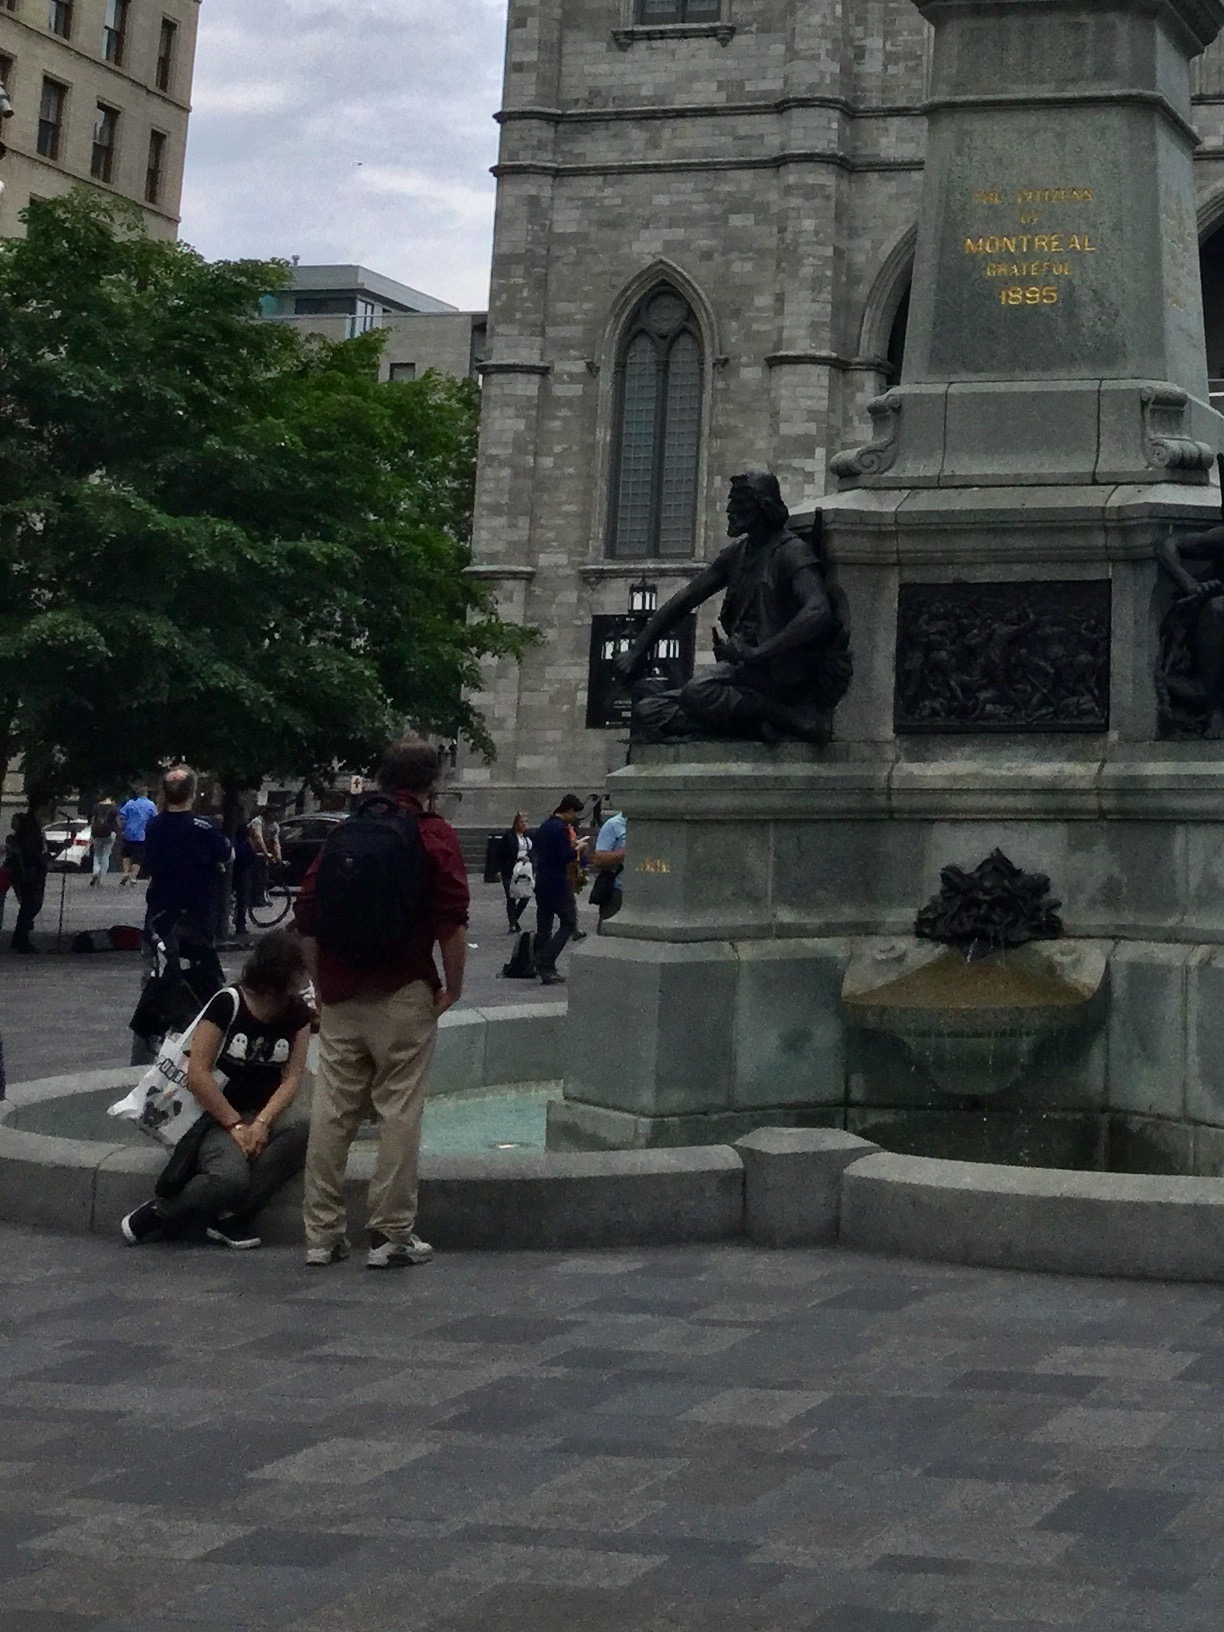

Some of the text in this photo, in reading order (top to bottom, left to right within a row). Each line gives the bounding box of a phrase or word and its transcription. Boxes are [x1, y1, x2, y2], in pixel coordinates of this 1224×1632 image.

[964, 233, 1096, 254] MONTREAL
[986, 260, 1071, 277] GRATEFUL
[999, 285, 1058, 305] 1895
